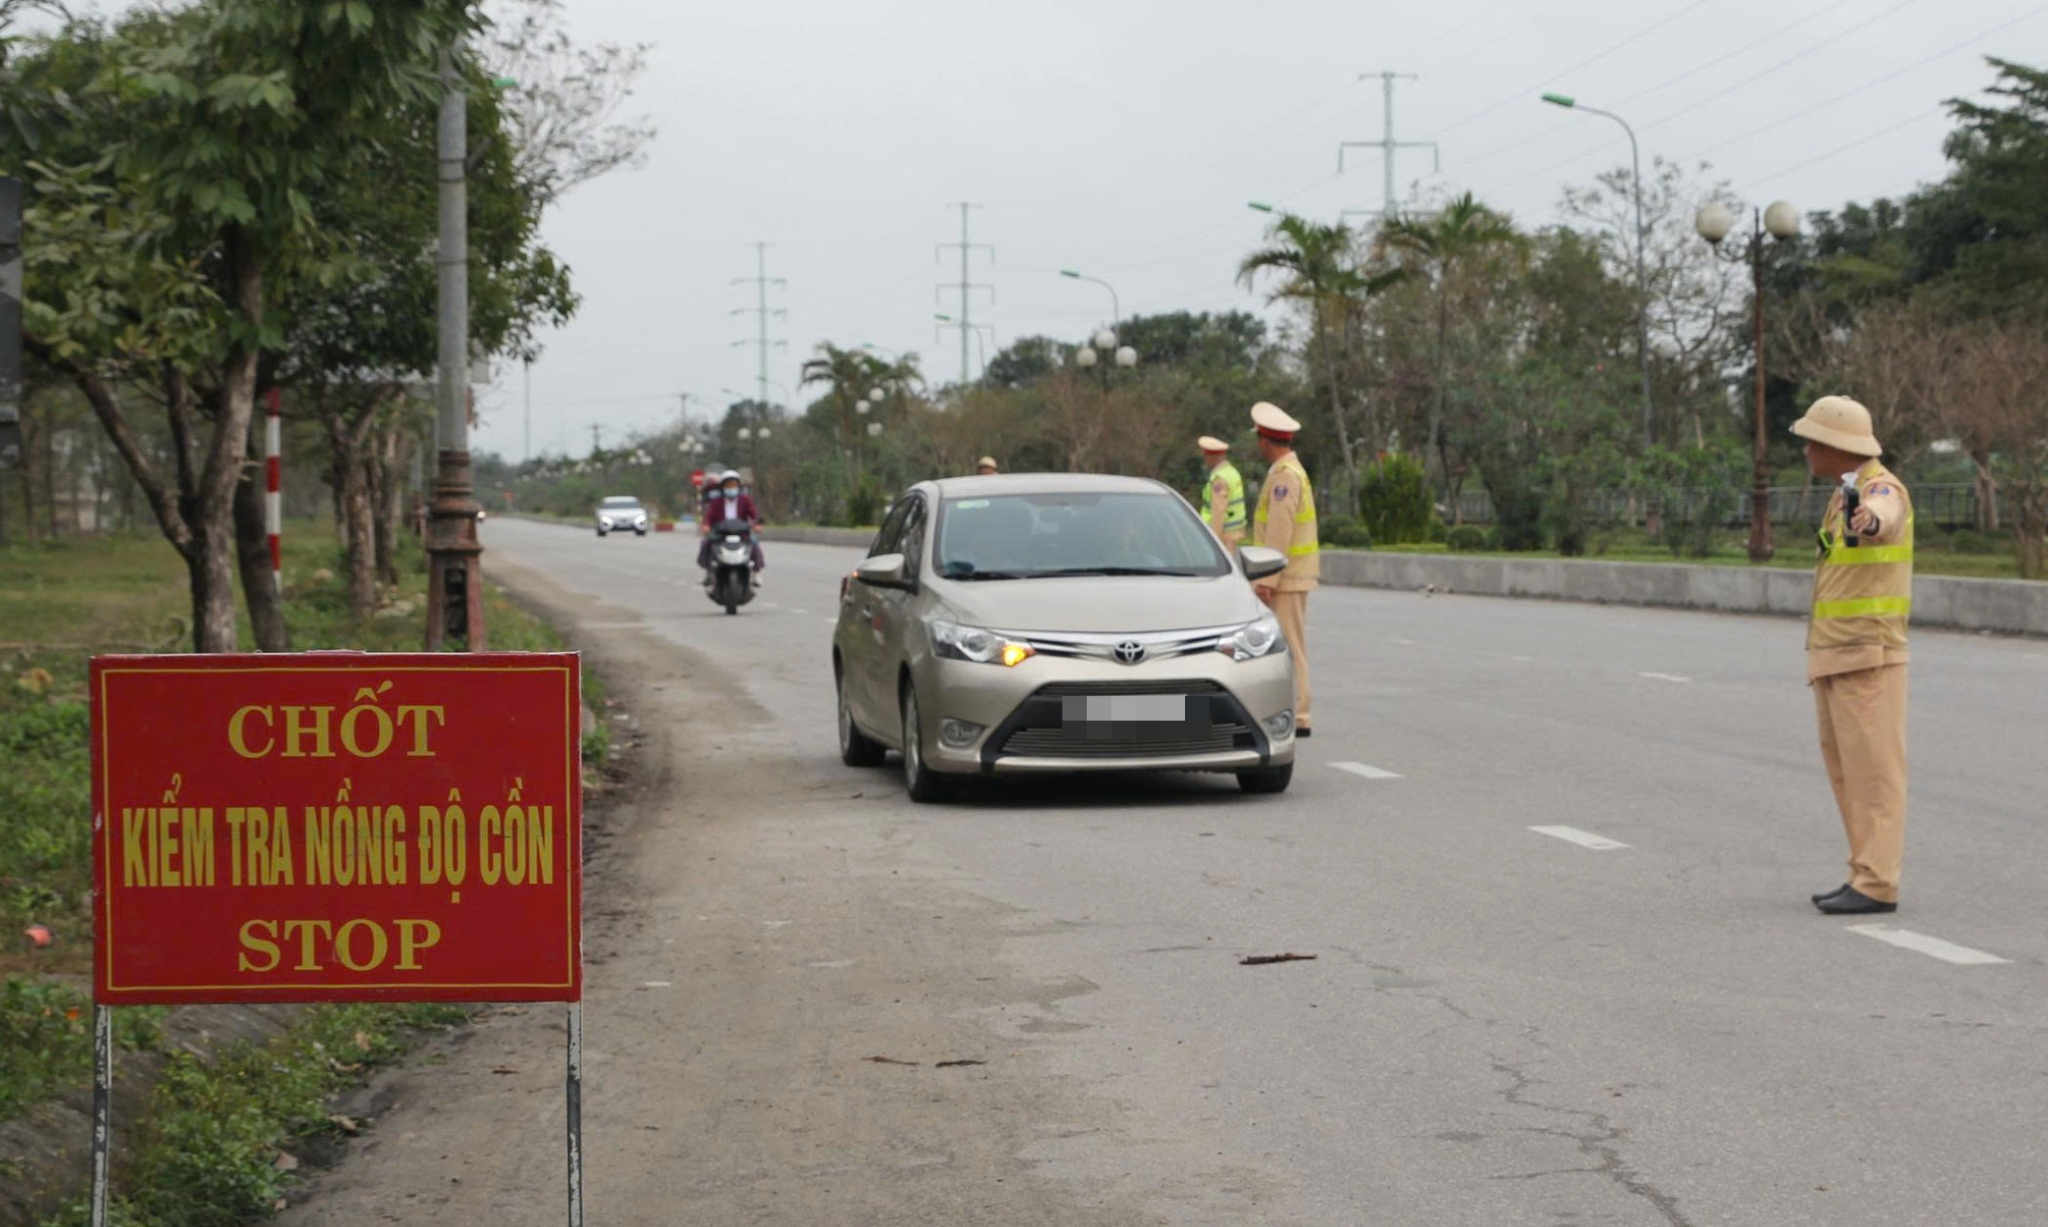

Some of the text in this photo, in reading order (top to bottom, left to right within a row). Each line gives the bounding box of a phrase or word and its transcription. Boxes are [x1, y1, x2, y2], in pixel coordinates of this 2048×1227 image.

[229, 681, 444, 758] CHỐT
[123, 774, 553, 903] KIỂM TRA NỒNG ĐỘ CỒN
[239, 919, 440, 971] STOP
